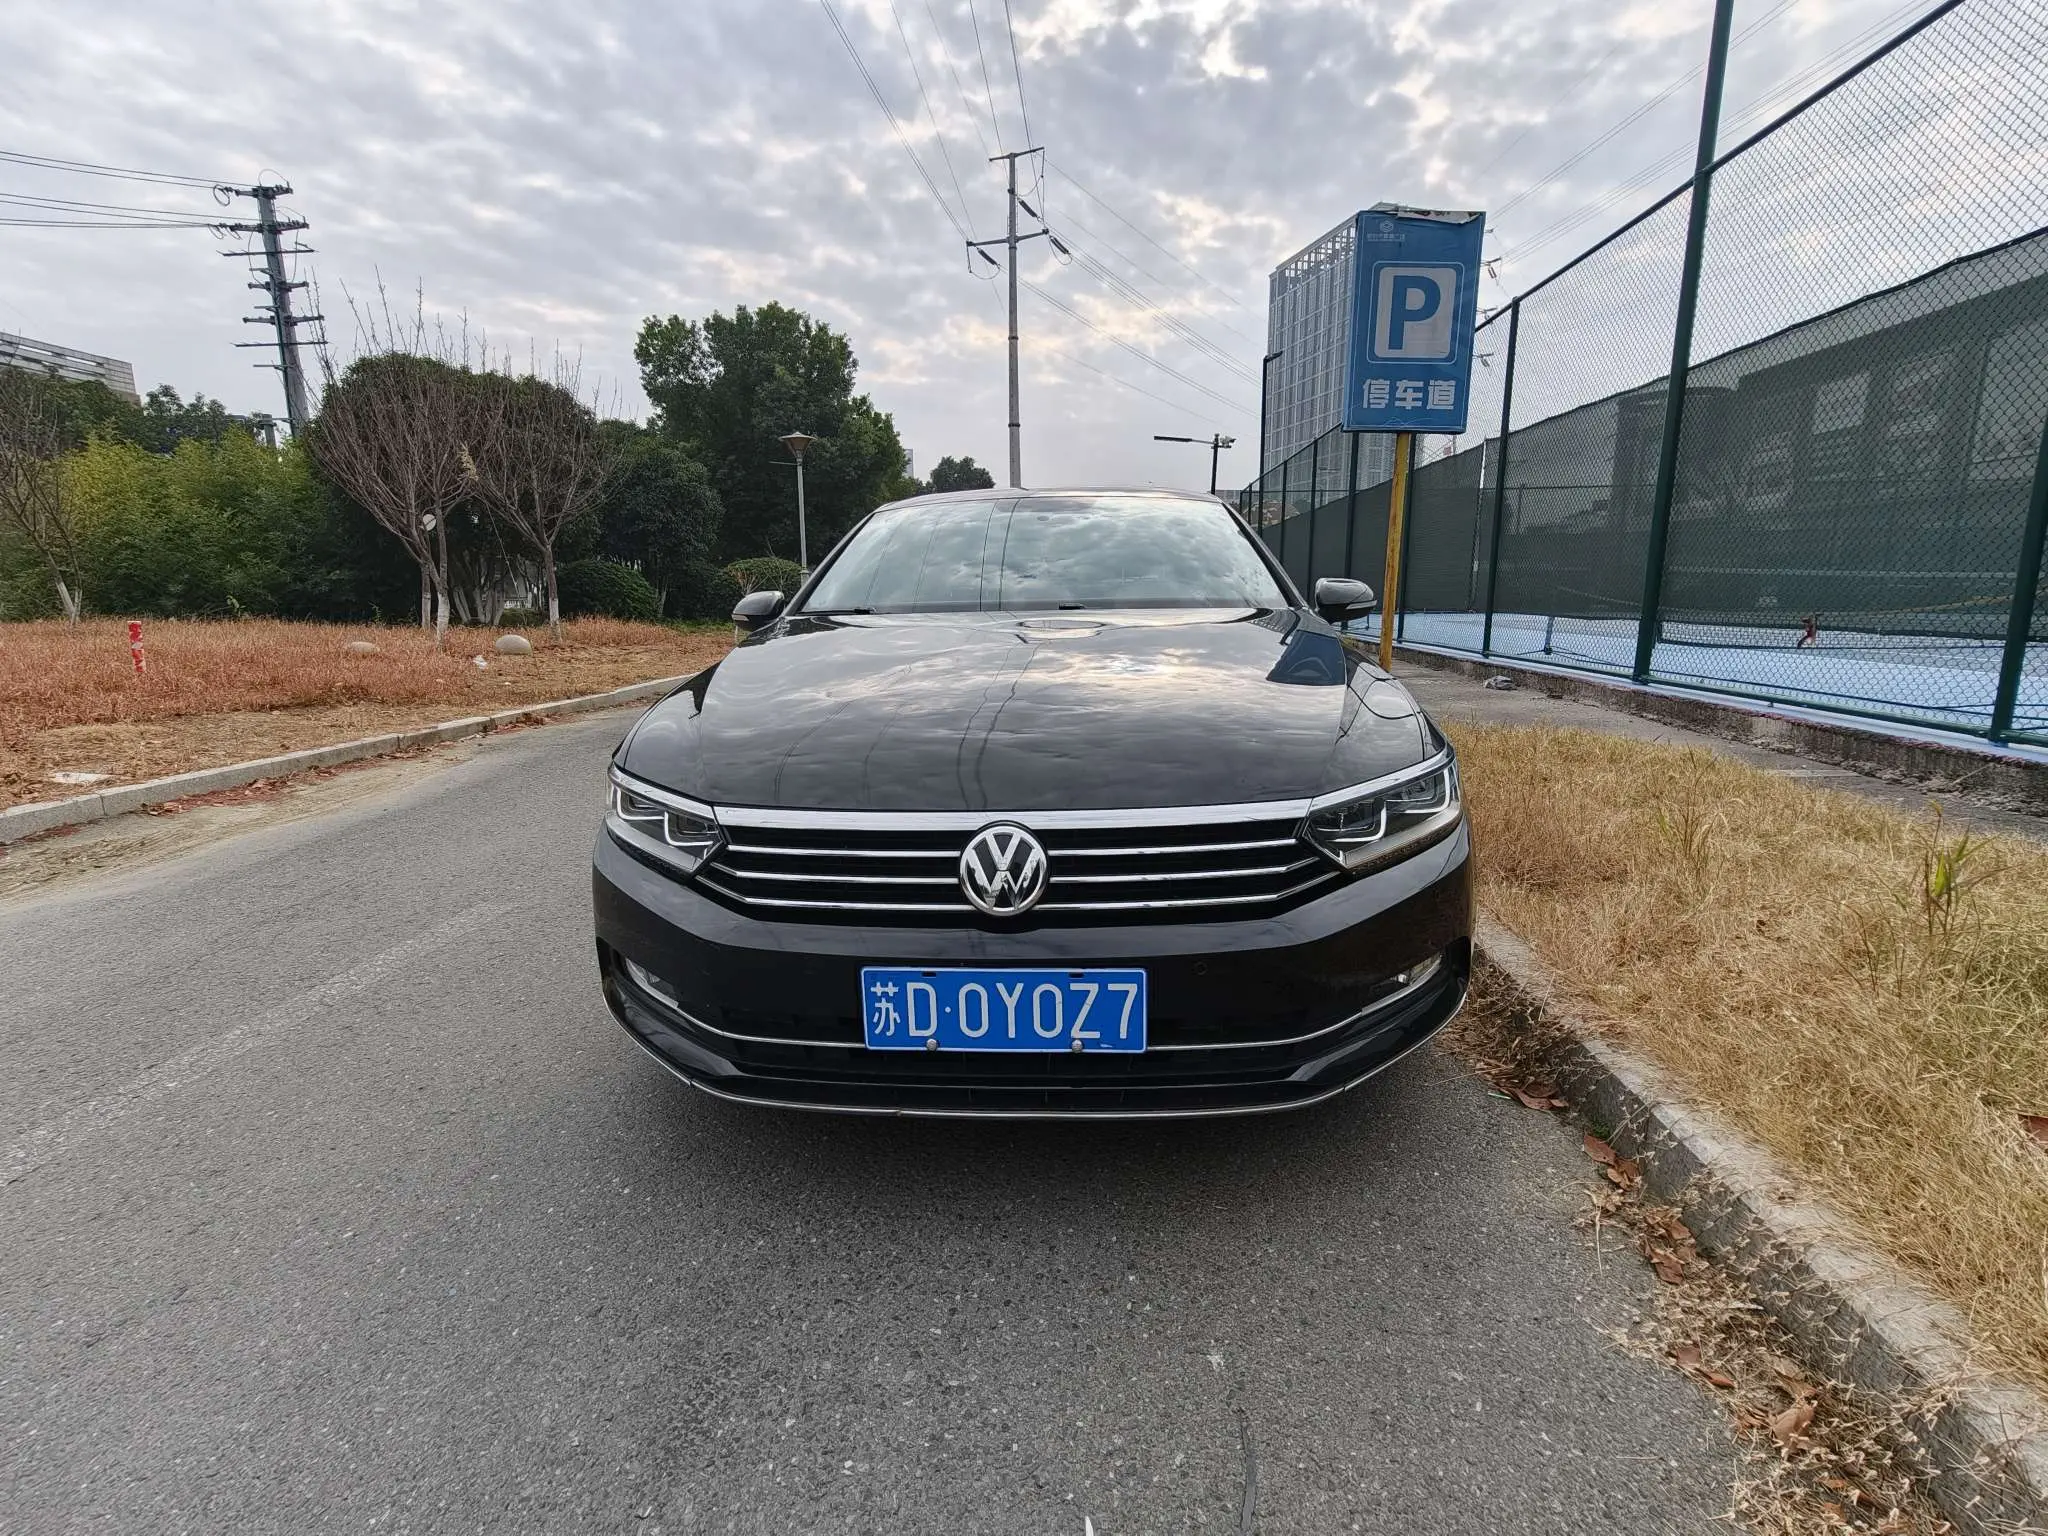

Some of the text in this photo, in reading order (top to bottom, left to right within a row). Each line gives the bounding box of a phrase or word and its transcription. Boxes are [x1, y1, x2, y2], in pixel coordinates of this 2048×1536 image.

[1387, 275, 1441, 350] P
[1362, 379, 1456, 410] 停车道
